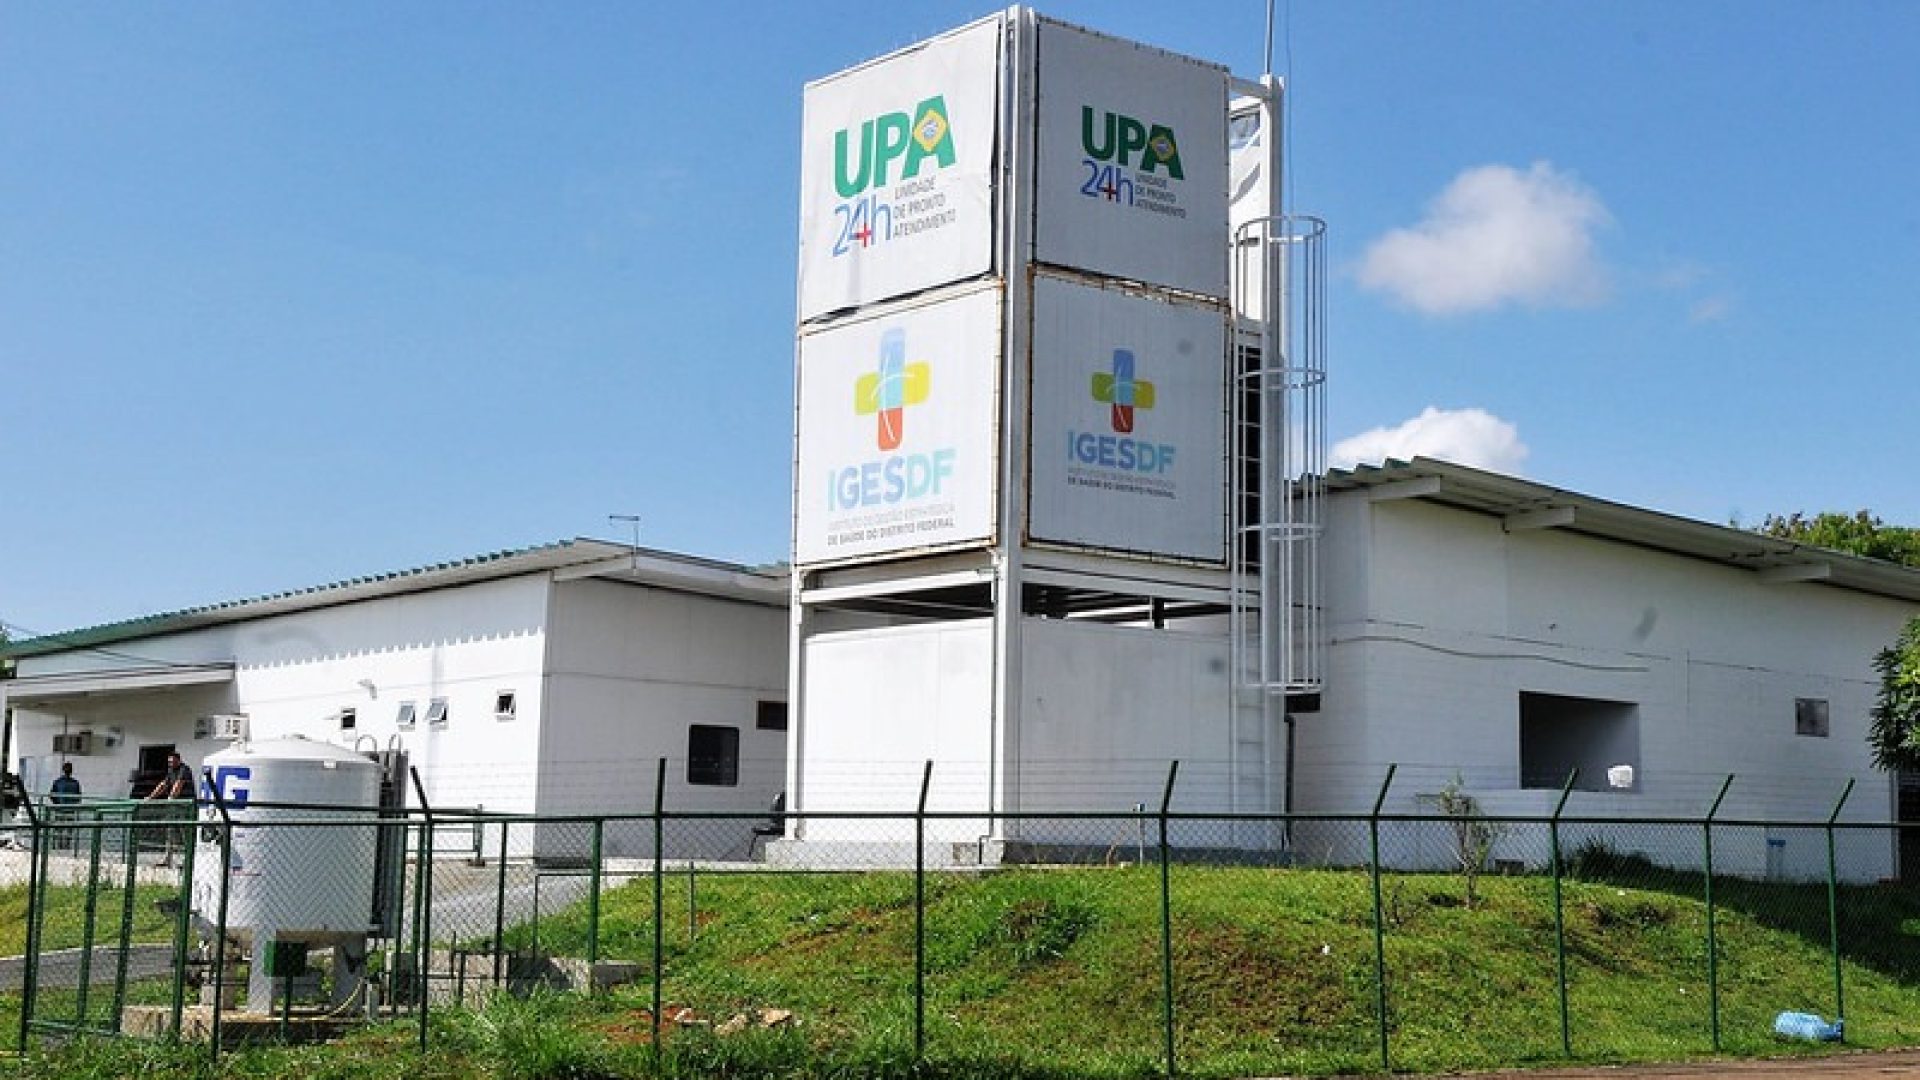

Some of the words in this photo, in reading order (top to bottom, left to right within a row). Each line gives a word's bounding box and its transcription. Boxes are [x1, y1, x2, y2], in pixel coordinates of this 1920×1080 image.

[835, 93, 956, 198] UPA
[1082, 105, 1185, 180] UPA
[1081, 160, 1134, 206] 24h
[833, 194, 891, 257] 24h
[828, 448, 956, 512] IGESDF
[1067, 431, 1176, 474] IGESDF
